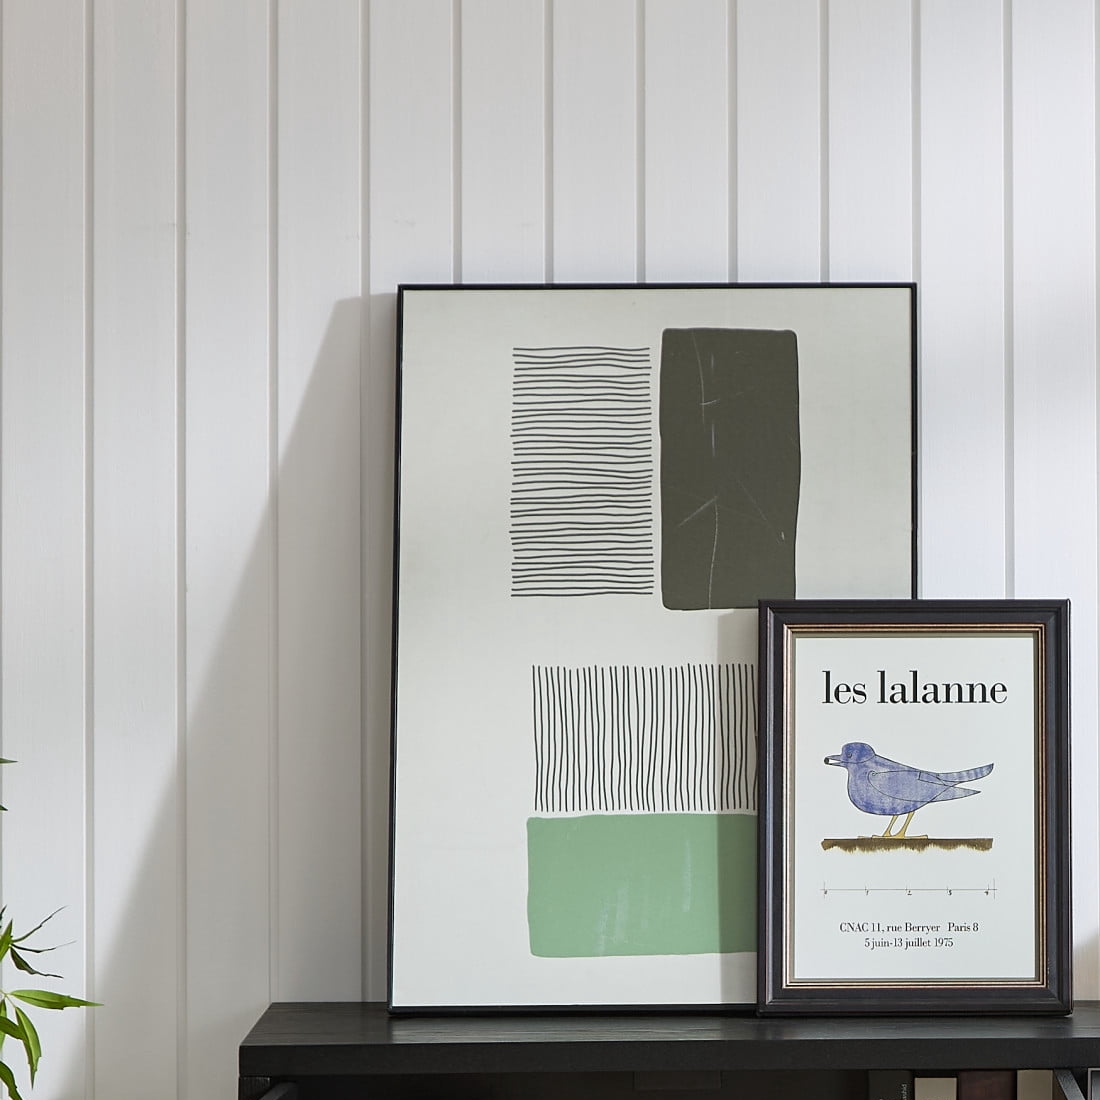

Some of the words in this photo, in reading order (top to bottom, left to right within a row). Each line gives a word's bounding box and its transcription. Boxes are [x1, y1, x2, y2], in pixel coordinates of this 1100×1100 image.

[821, 670, 867, 704] les
[876, 670, 1008, 704] lalanne
[839, 922, 869, 932] CNAC
[871, 922, 884, 934] 11,
[904, 922, 941, 935] Berryer
[947, 922, 971, 932] Paris
[972, 922, 979, 932] 8
[864, 937, 870, 947] 5
[871, 937, 903, 950] juin-13
[904, 937, 931, 950] juillet
[934, 937, 954, 947] 1975
